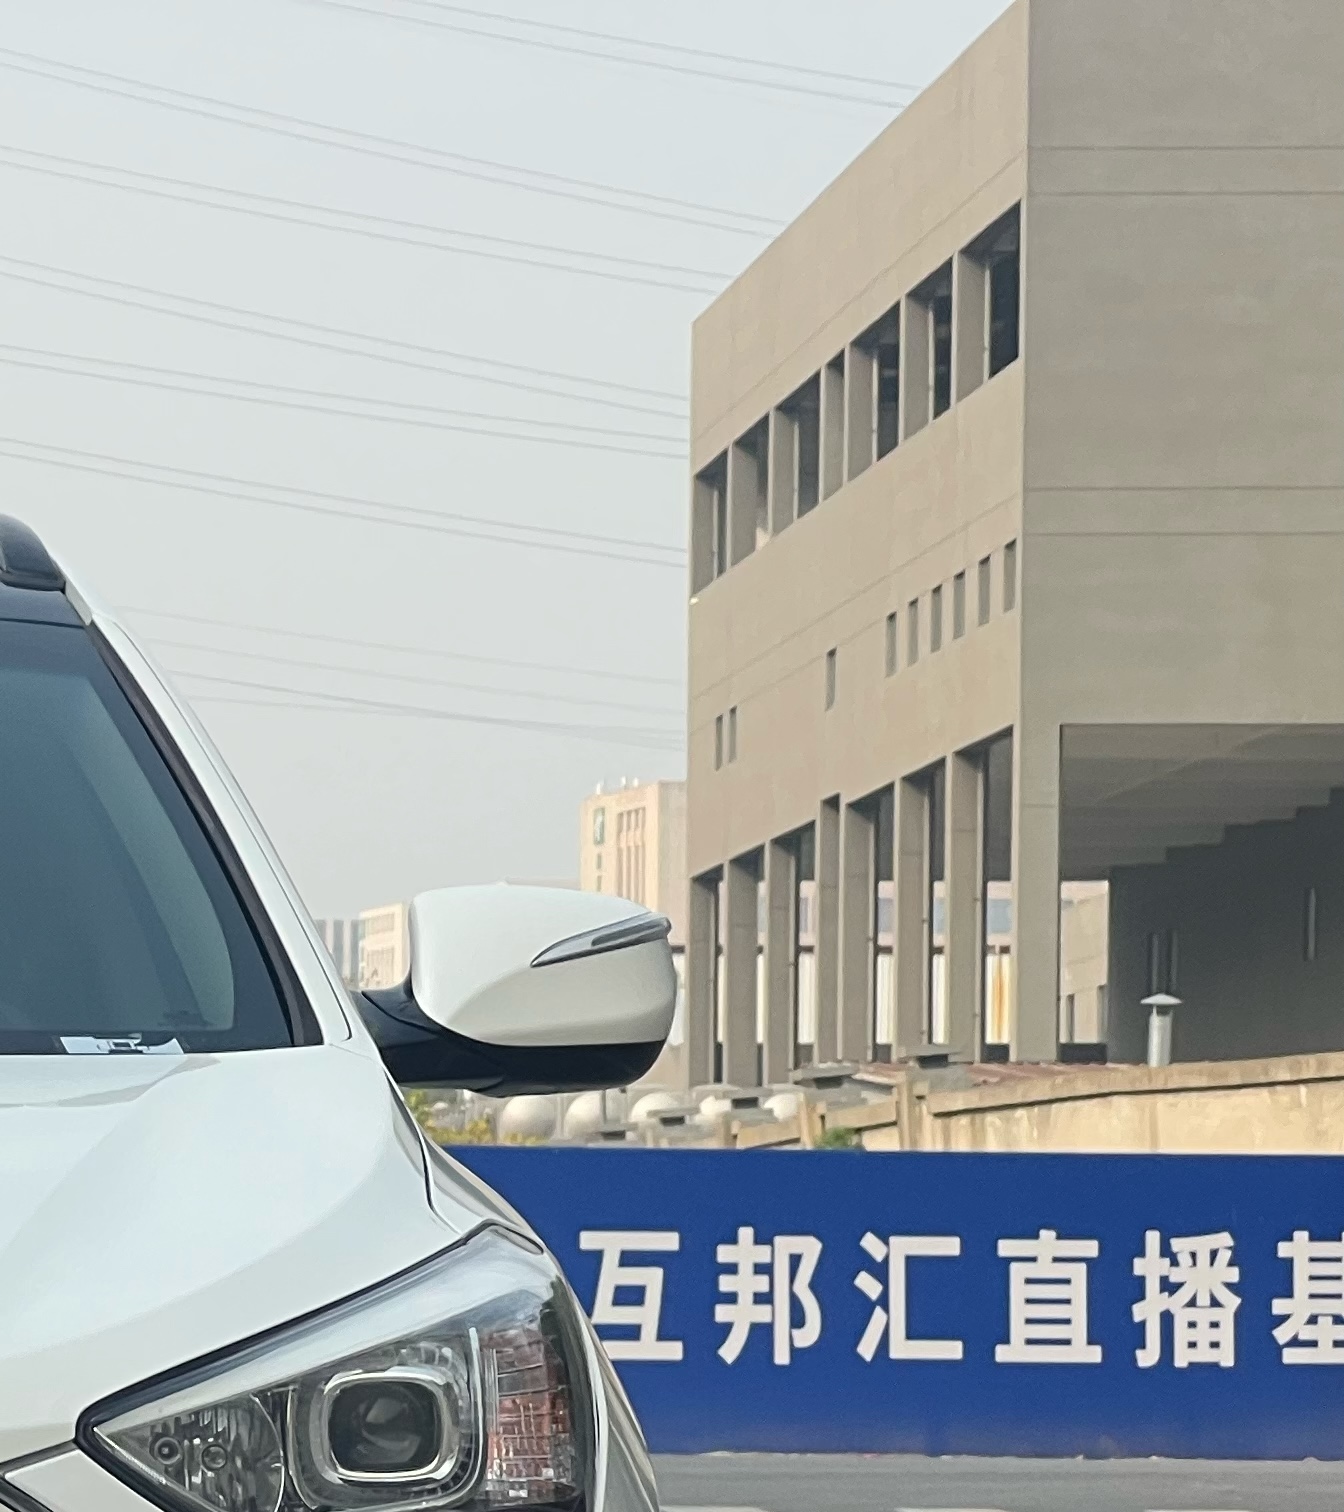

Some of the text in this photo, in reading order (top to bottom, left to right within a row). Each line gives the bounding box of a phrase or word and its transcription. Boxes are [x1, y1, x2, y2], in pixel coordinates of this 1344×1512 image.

[579, 1226, 1344, 1367] 互邦汇直播基
